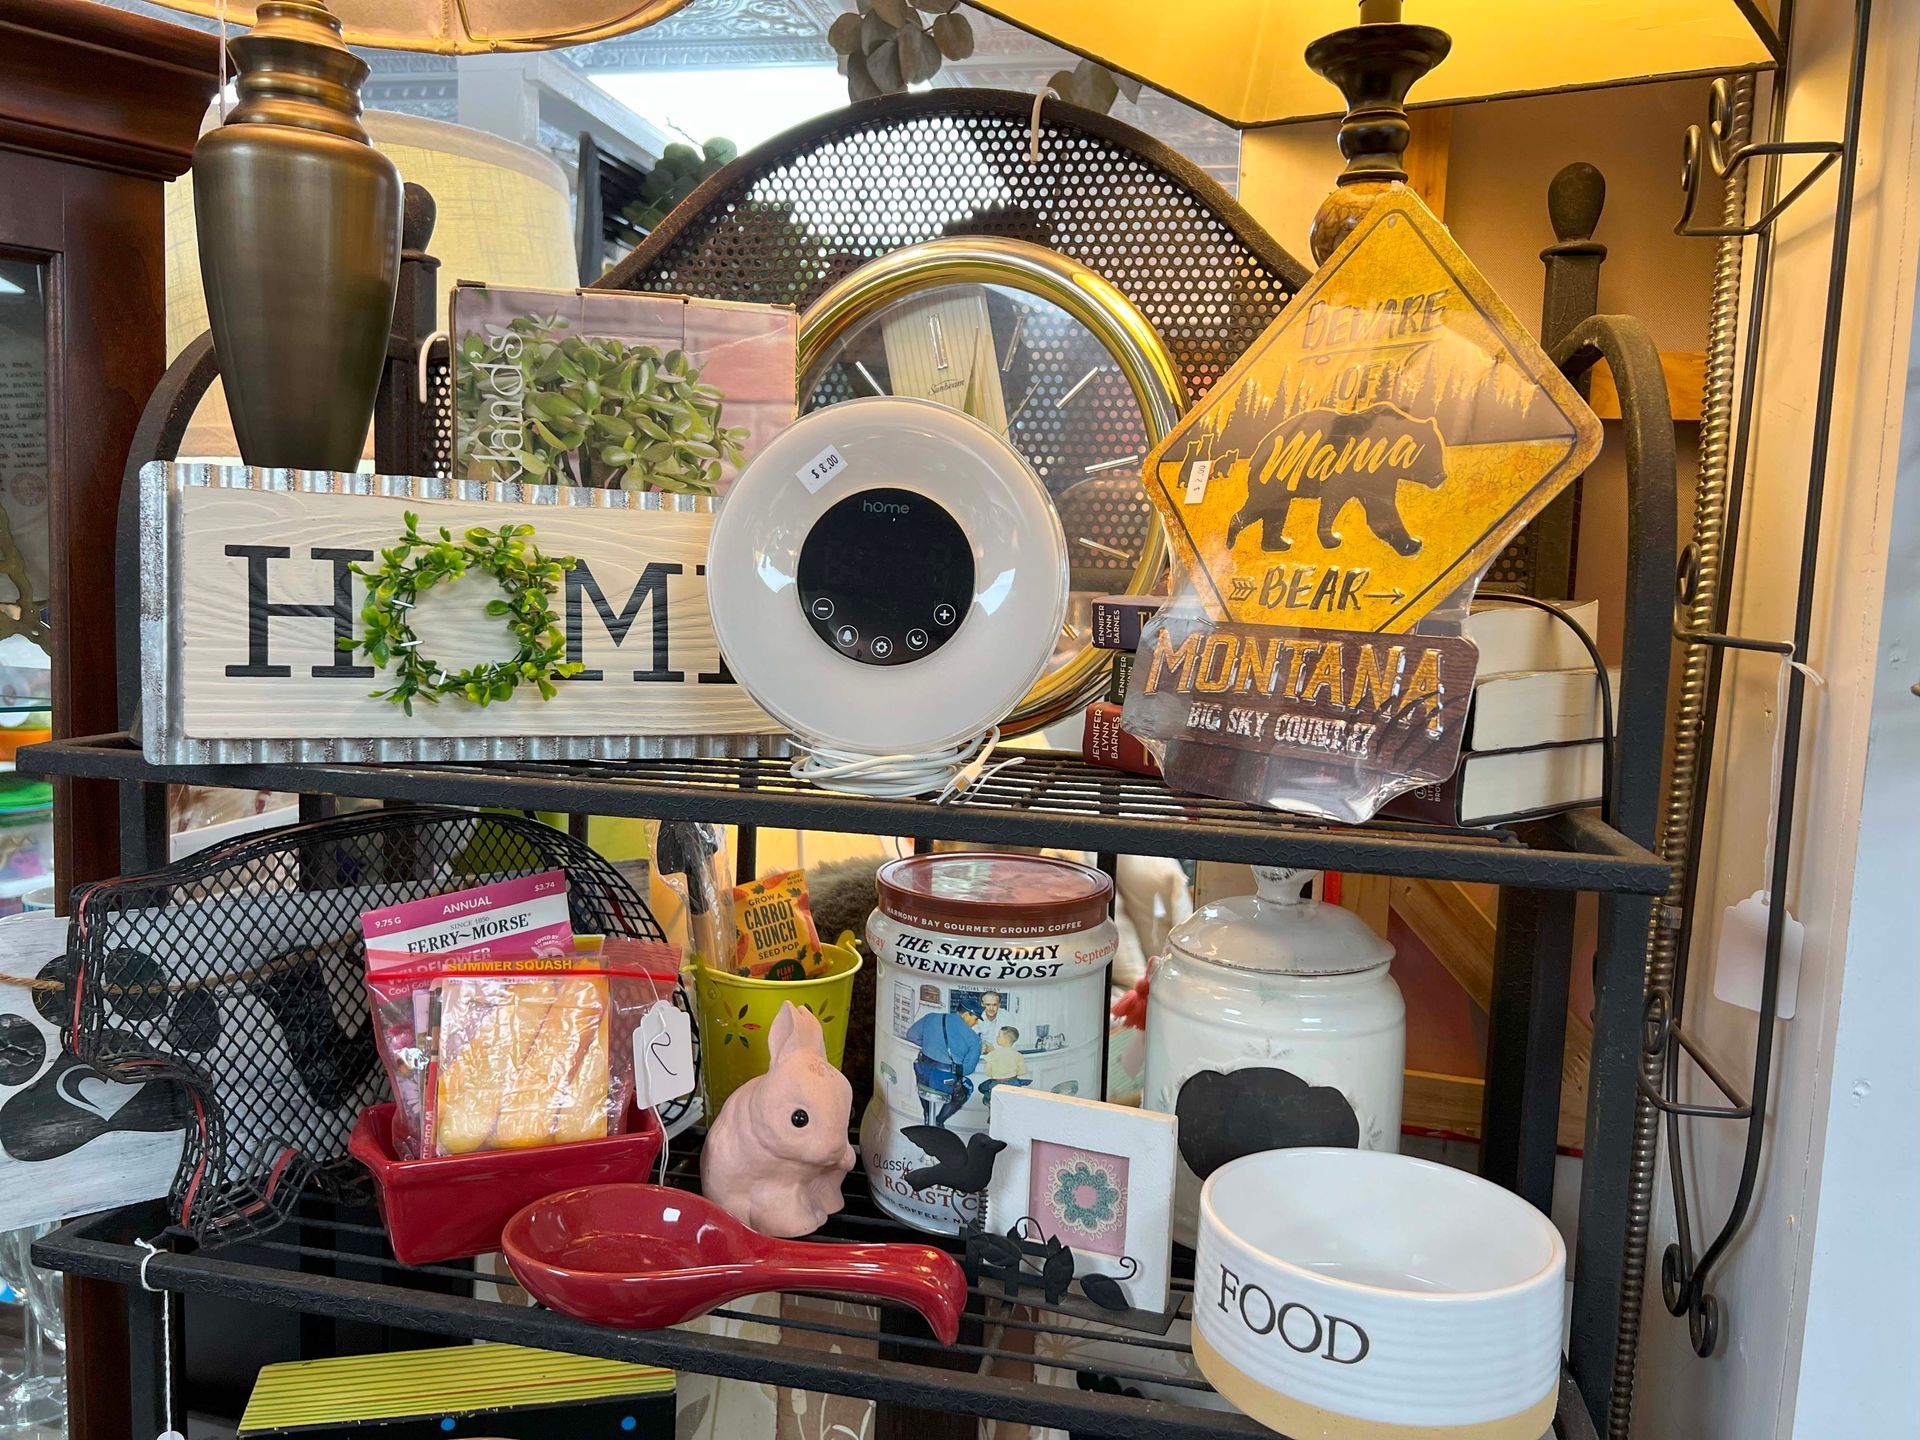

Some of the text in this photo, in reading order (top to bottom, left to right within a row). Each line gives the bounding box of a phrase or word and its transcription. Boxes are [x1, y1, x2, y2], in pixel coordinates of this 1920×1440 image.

[1302, 289, 1450, 350] BEWARE
[1337, 362, 1392, 401] OF
[819, 454, 839, 473] 8.00
[1259, 429, 1425, 491] Mama
[863, 500, 910, 514] home
[1259, 566, 1370, 610] BEAR
[1118, 656, 1127, 699] JENNIFER
[1144, 626, 1443, 740] MONTANA
[1092, 709, 1103, 761] JENNIFER
[1101, 721, 1110, 751] LYNN
[1186, 702, 1222, 731] BIG
[1226, 707, 1270, 741] SKY
[1111, 716, 1121, 760] BARNES
[534, 881, 556, 892] $3.74
[748, 894, 775, 906] GROW
[442, 896, 493, 915] ANNUAL
[744, 899, 795, 930] CARROT
[886, 907, 1082, 934] HARMONY BAY GOURMET GROUND COFFEE
[375, 917, 402, 929] 9.75 G
[450, 916, 490, 931] SINCE 1856
[753, 920, 798, 951] BUNCH
[448, 959, 572, 971] SUMMER SQUASH
[758, 941, 800, 961] SEED POP
[895, 933, 1060, 967] THE SATURDAY
[895, 951, 1063, 980] EVENING POST
[388, 985, 410, 996] Cool
[873, 1153, 914, 1171] Classic
[884, 1175, 952, 1208] ROAST
[1218, 1264, 1370, 1364] FOOD
